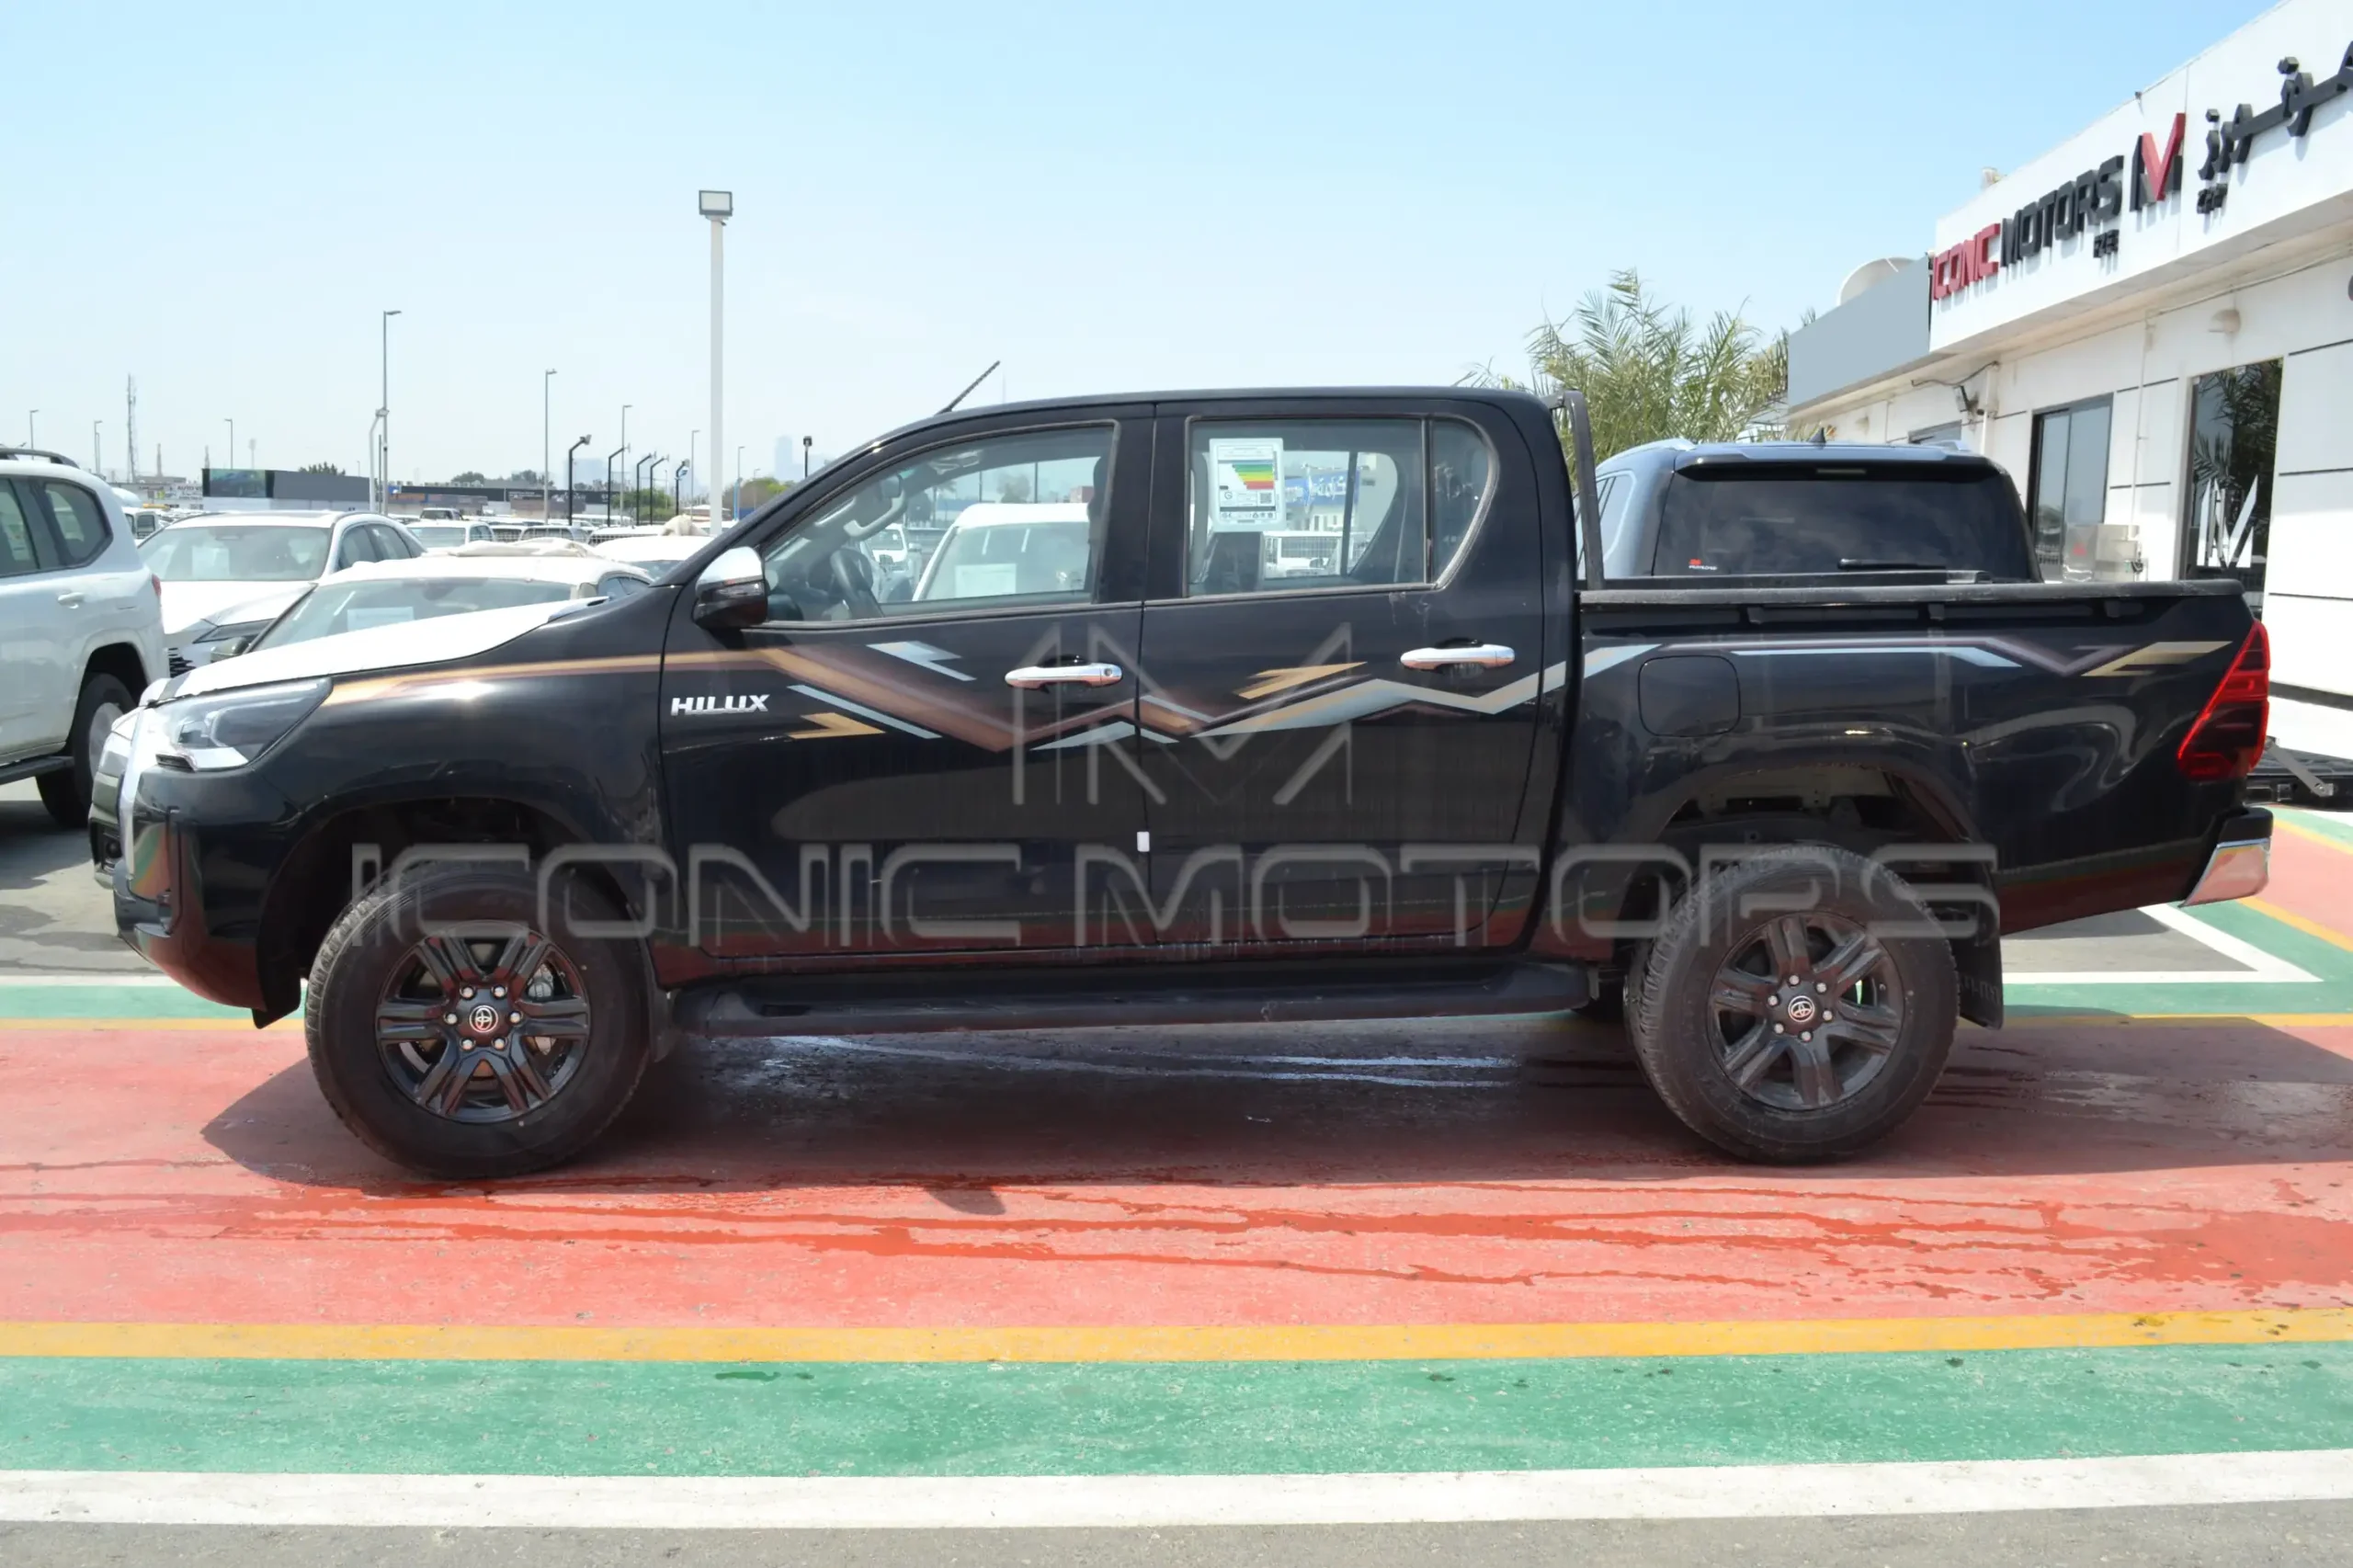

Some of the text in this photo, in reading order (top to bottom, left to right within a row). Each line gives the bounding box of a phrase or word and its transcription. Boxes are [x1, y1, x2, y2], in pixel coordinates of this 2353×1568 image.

[1933, 154, 2124, 301] ICONIC MOTORS
[670, 694, 770, 716] HILUX
